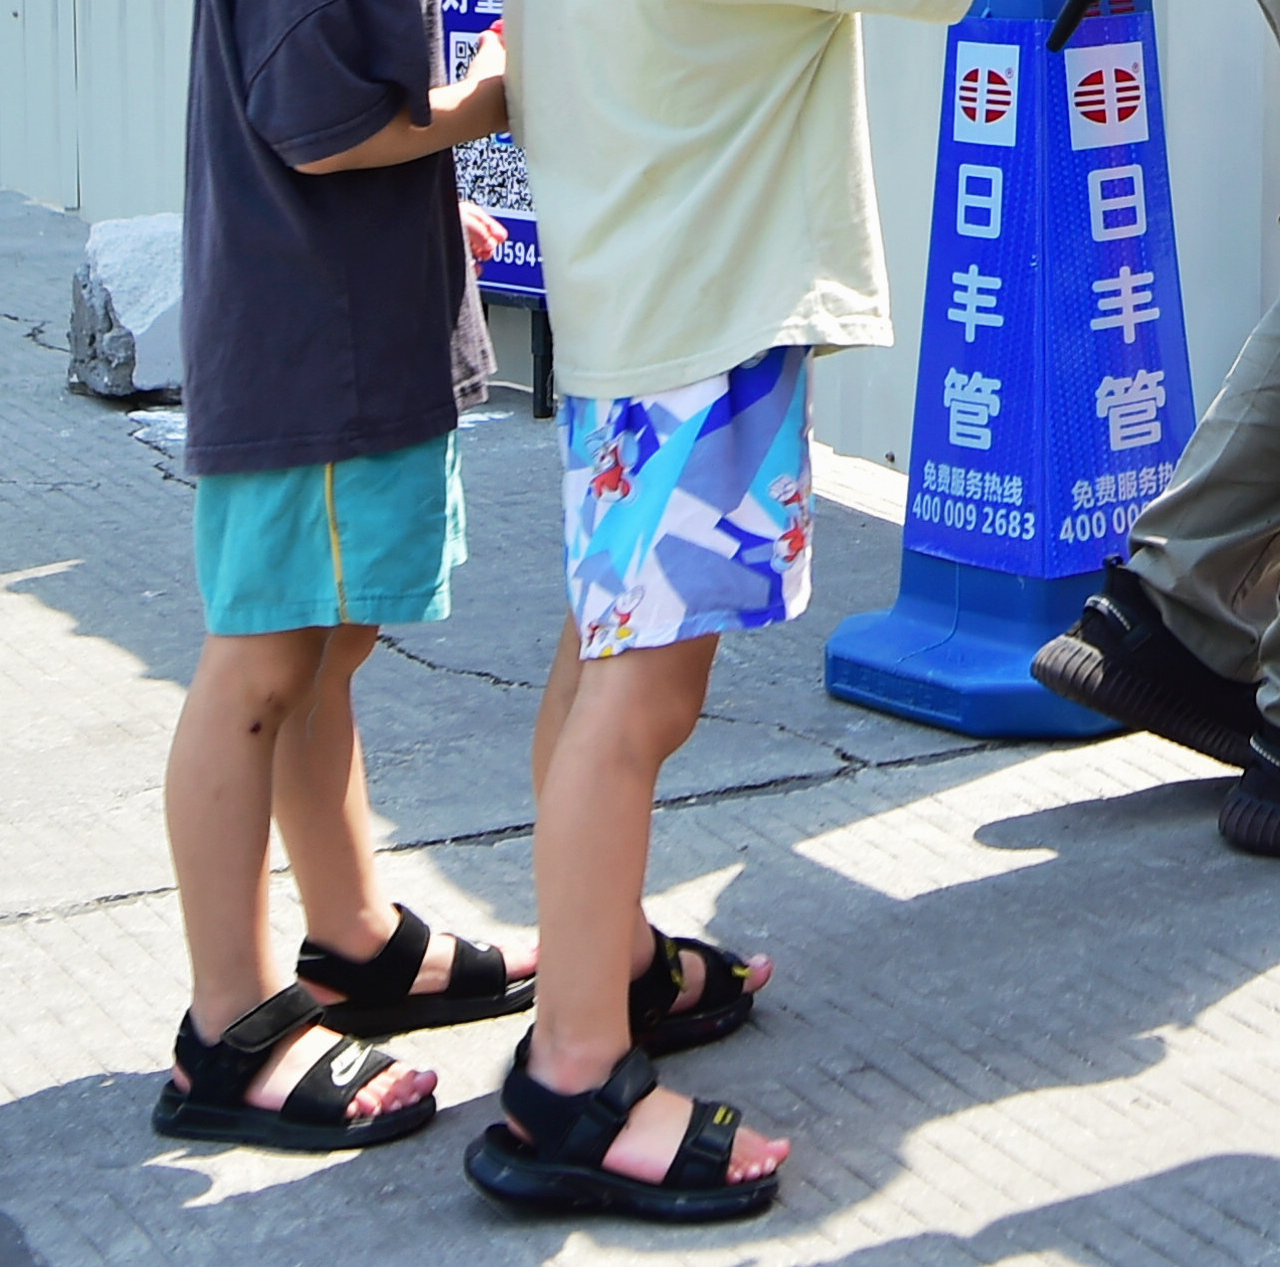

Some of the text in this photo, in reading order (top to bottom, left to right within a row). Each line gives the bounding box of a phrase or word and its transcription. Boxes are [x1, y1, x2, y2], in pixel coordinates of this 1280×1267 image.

[943, 163, 1004, 451] 日丰管
[1086, 163, 1167, 452] 日丰管
[922, 459, 1024, 507] 免费服务热线
[912, 492, 1036, 540] 400 009 2683
[1059, 500, 1150, 544] 400 00
